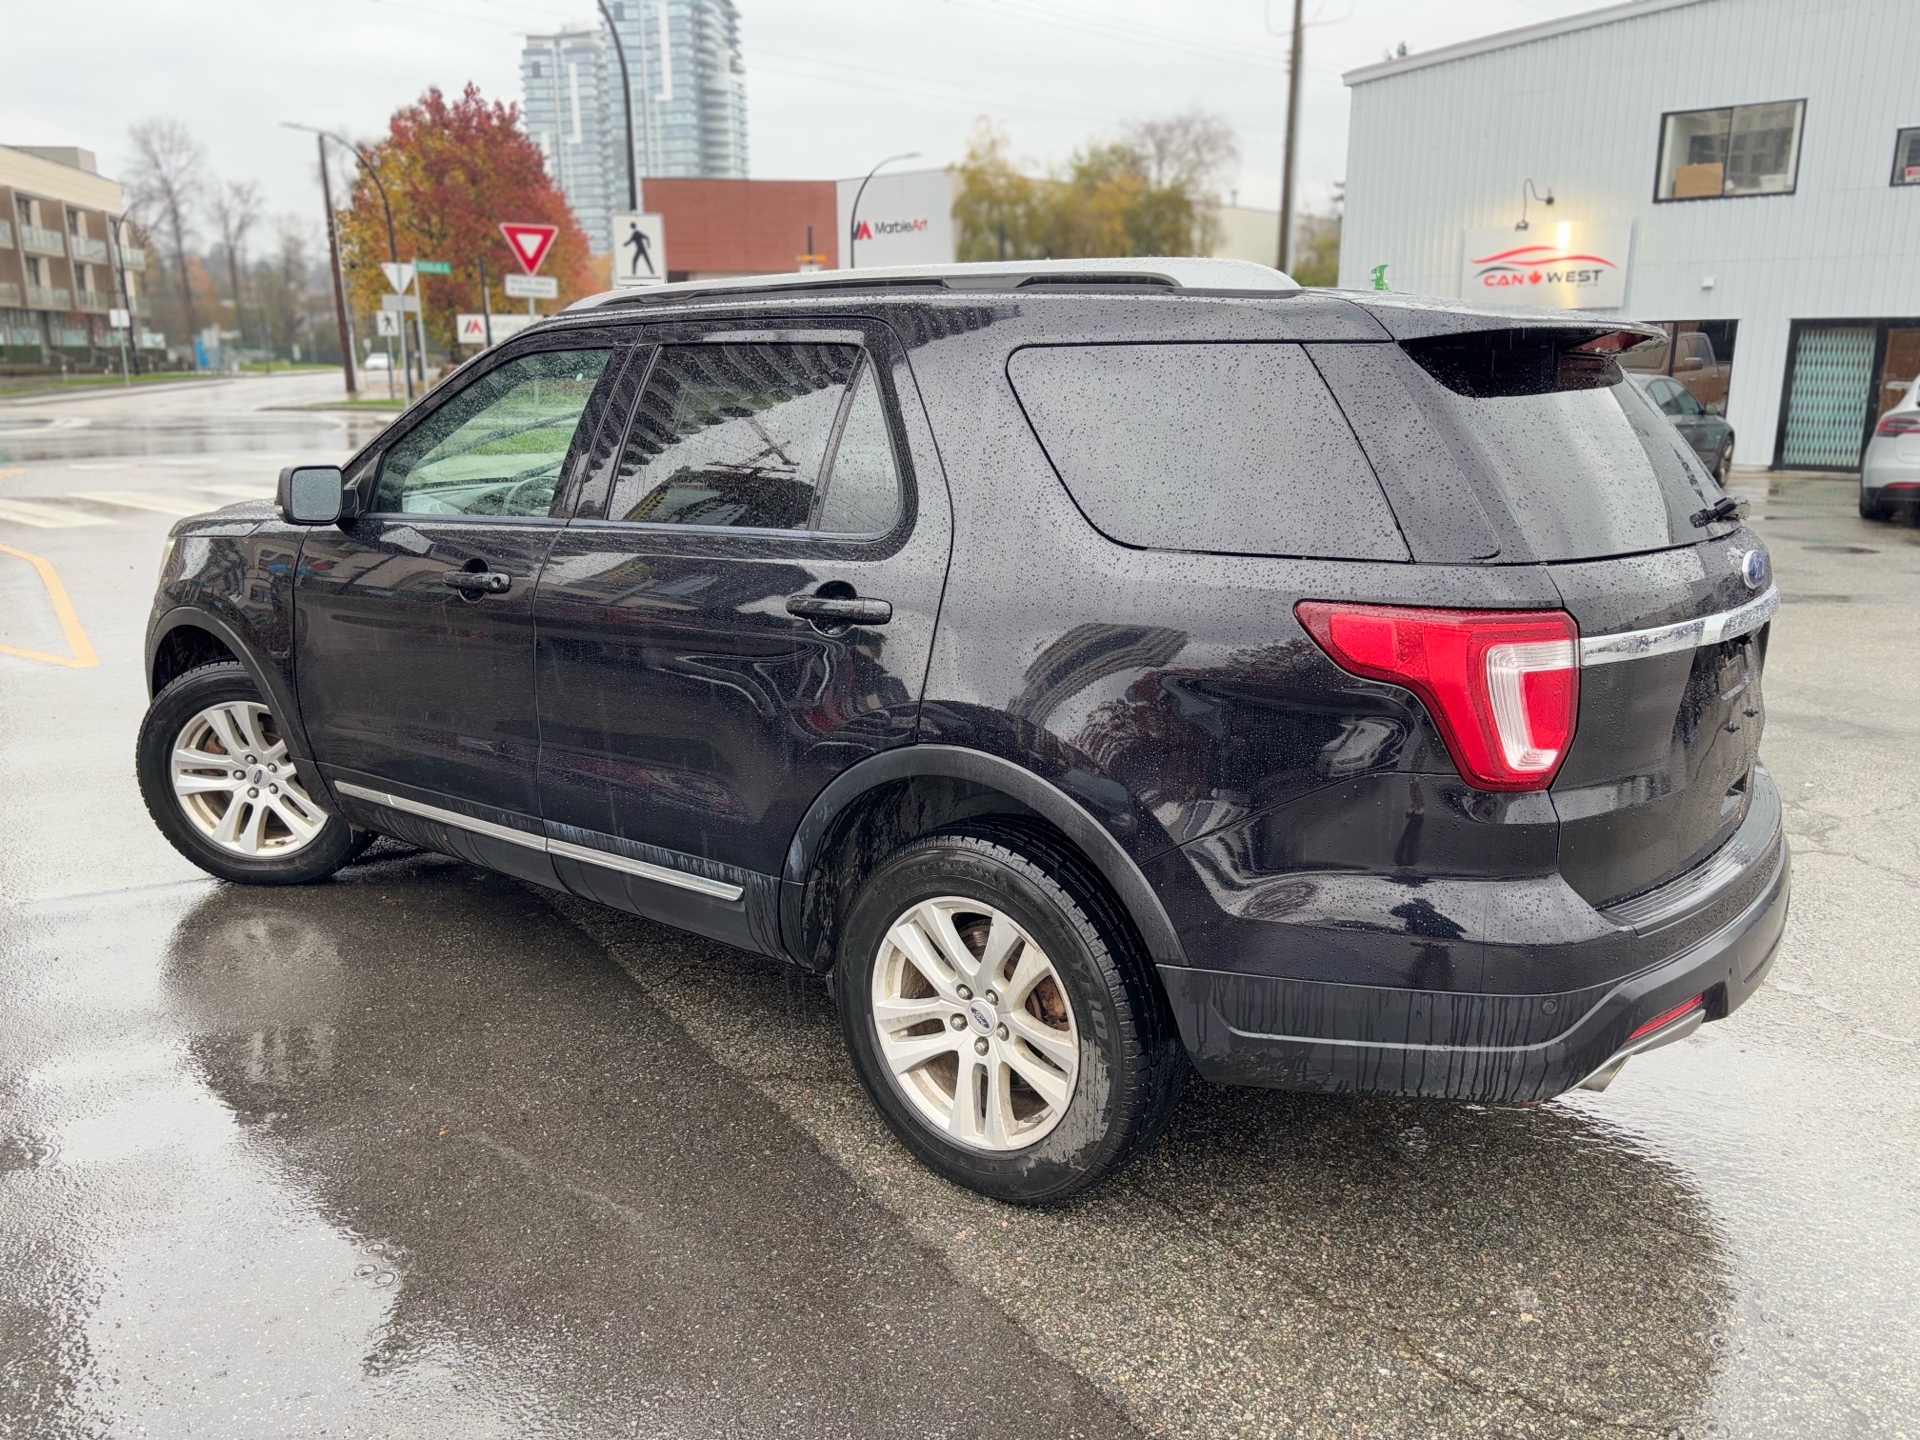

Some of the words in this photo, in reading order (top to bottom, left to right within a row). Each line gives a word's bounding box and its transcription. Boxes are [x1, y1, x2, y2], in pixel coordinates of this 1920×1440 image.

[875, 219, 927, 234] MarbleArt
[1484, 273, 1524, 287] CAN
[1547, 269, 1604, 283] WEST
